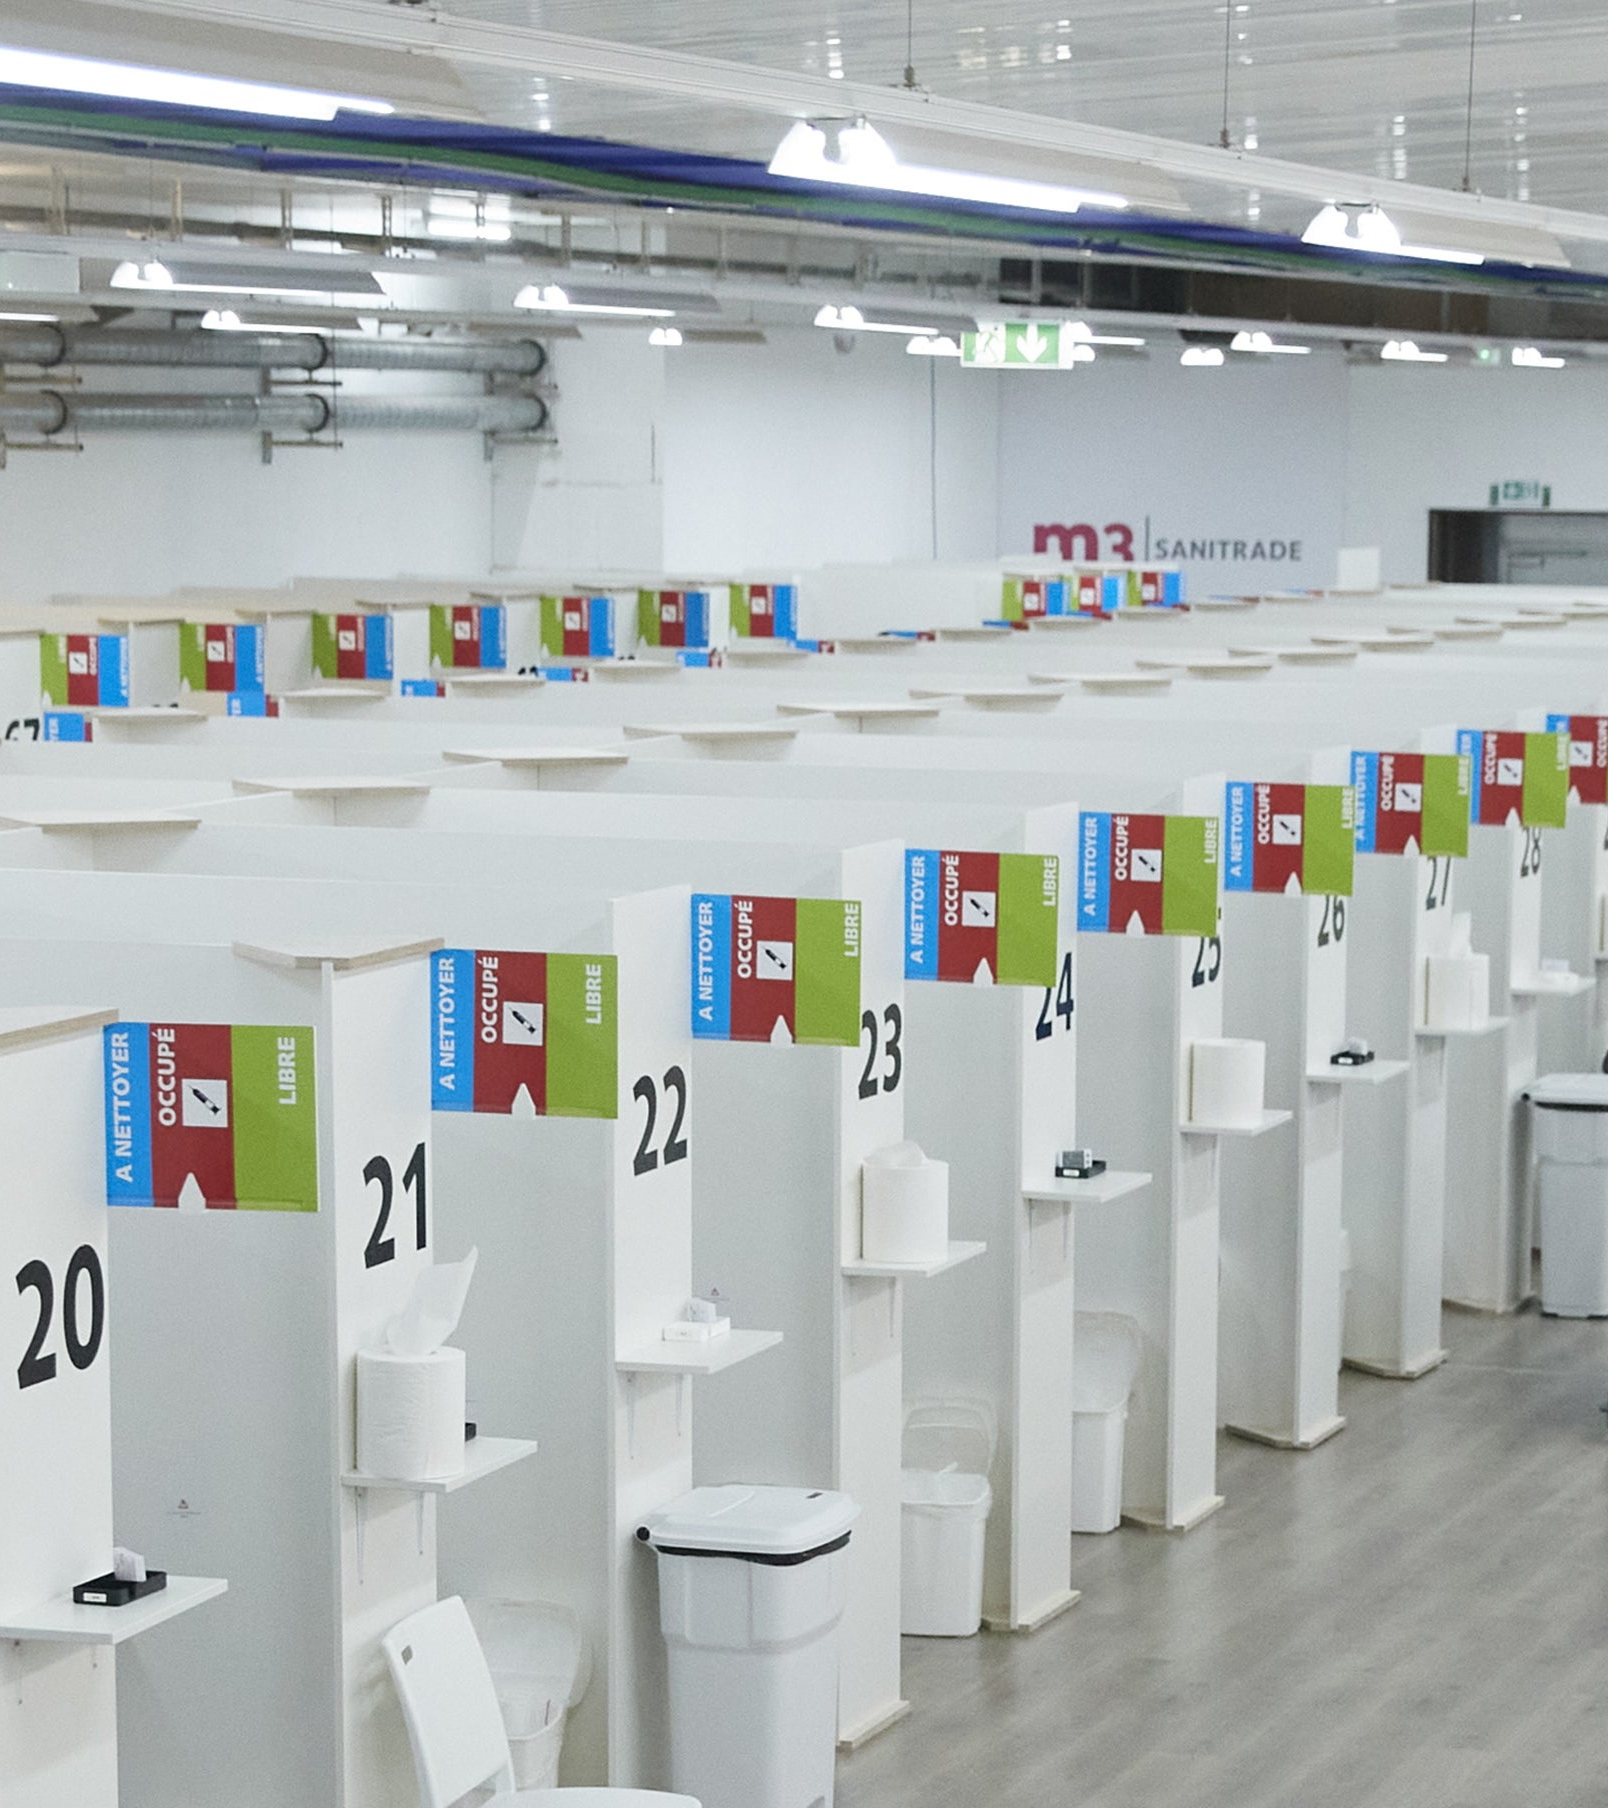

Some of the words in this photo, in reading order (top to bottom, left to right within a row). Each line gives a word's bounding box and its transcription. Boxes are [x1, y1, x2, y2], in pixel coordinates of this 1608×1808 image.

[1156, 538, 1303, 561] SANITRADE
[1111, 815, 1129, 881] OCCUPÉ
[1204, 819, 1218, 864] LIBRE
[1230, 786, 1245, 863] NETTOYER
[1256, 783, 1271, 845] OCCUPÉ
[941, 854, 960, 927] OCCUPÉ
[1042, 857, 1058, 907] LIBRE
[1084, 816, 1098, 902] NETTOYER
[1229, 865, 1242, 878] A
[844, 902, 859, 957] LIBRE
[911, 855, 926, 946] NETTOYER
[1083, 903, 1096, 917] A
[698, 901, 713, 1001] NETTOYER
[733, 900, 753, 979] OCCUPÉ
[910, 950, 924, 964] A
[438, 957, 455, 1068] NETTOYER
[477, 956, 499, 1044] OCCUPÉ
[585, 963, 602, 1025] LIBRE
[698, 1005, 714, 1022] A
[152, 1027, 177, 1128] OCCUPÉ
[277, 1035, 298, 1106] LIBRE
[439, 1073, 456, 1090] A
[858, 1003, 902, 1100] 23
[111, 1031, 132, 1159] NETTOYER
[632, 1065, 688, 1177] 22
[114, 1163, 134, 1183] A
[362, 1140, 428, 1270] 21
[15, 1243, 105, 1390] 20
